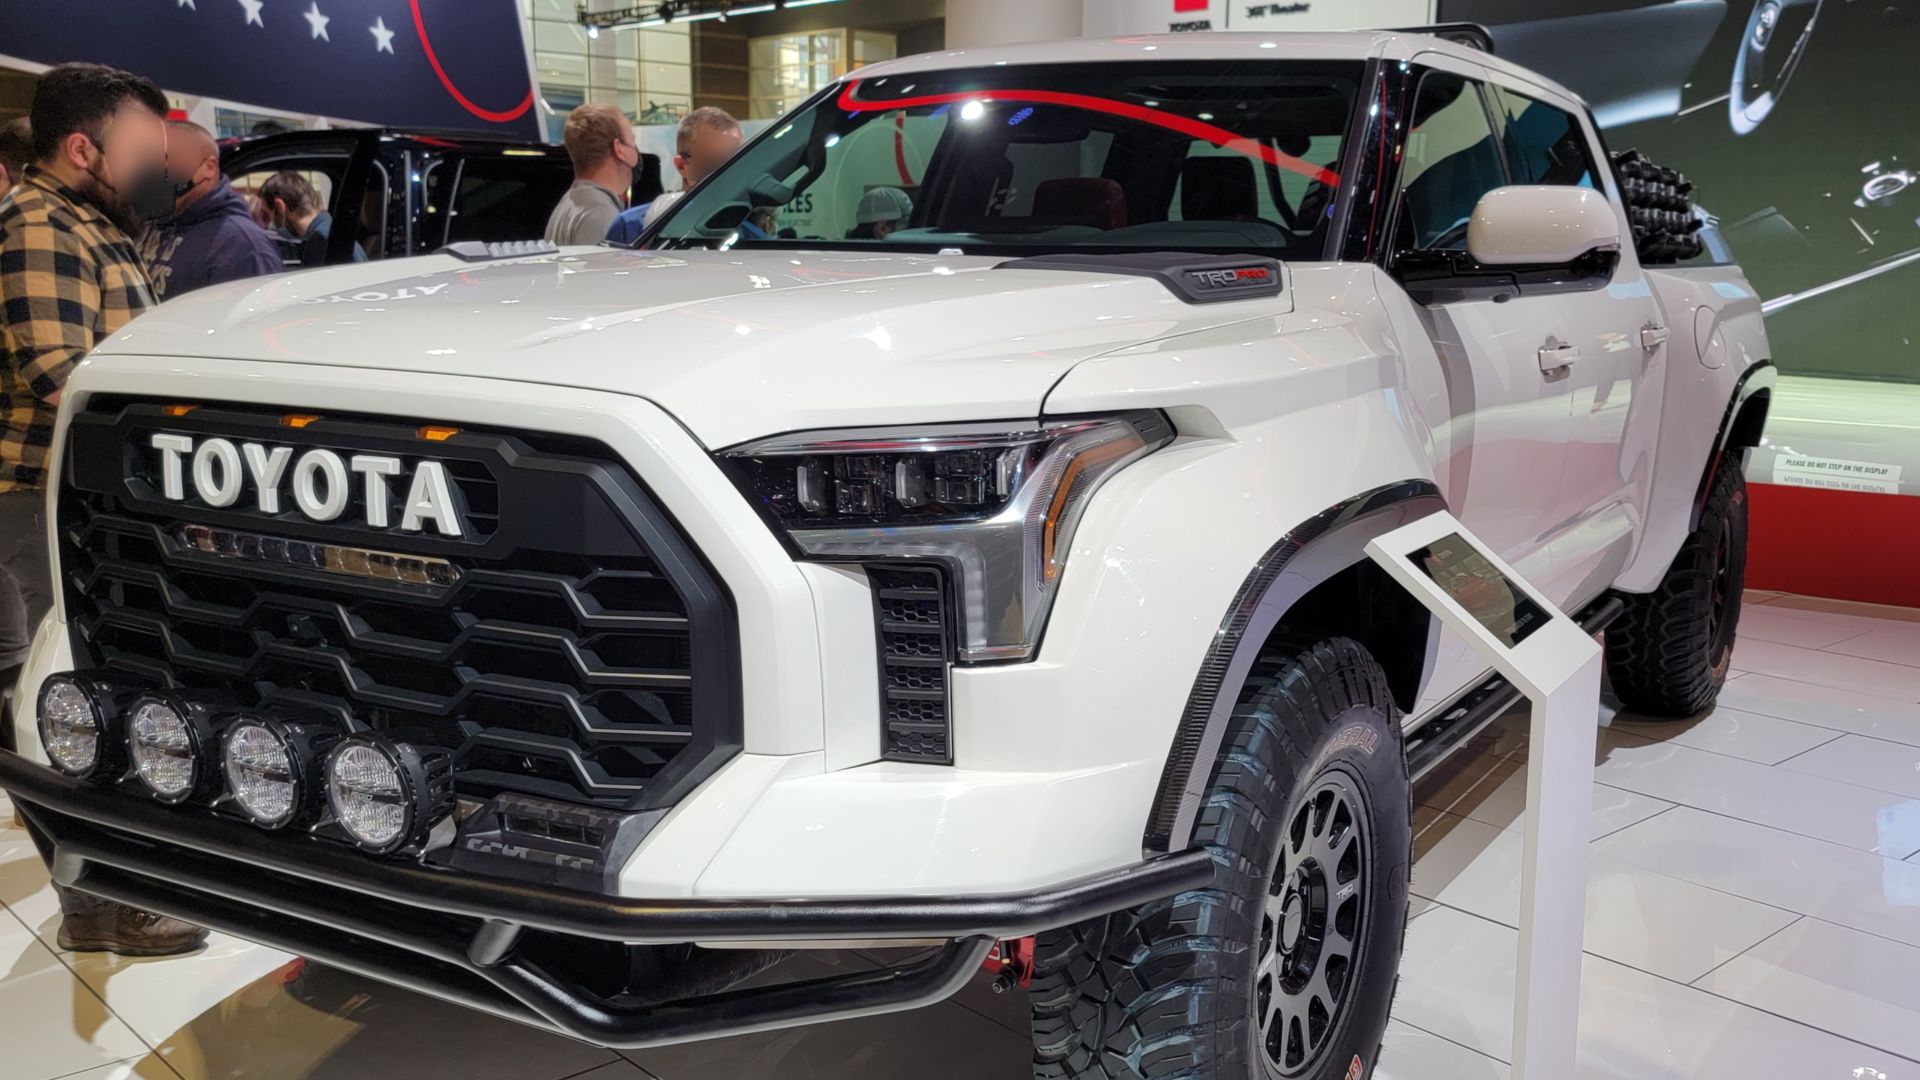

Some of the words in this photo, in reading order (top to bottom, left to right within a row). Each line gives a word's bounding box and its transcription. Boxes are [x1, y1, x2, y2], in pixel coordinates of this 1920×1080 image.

[1169, 20, 1211, 32] TOYOTA
[1785, 459, 1805, 467] PLEASE
[1864, 467, 1888, 475] DISPLAY
[152, 433, 462, 536] TOYOTA
